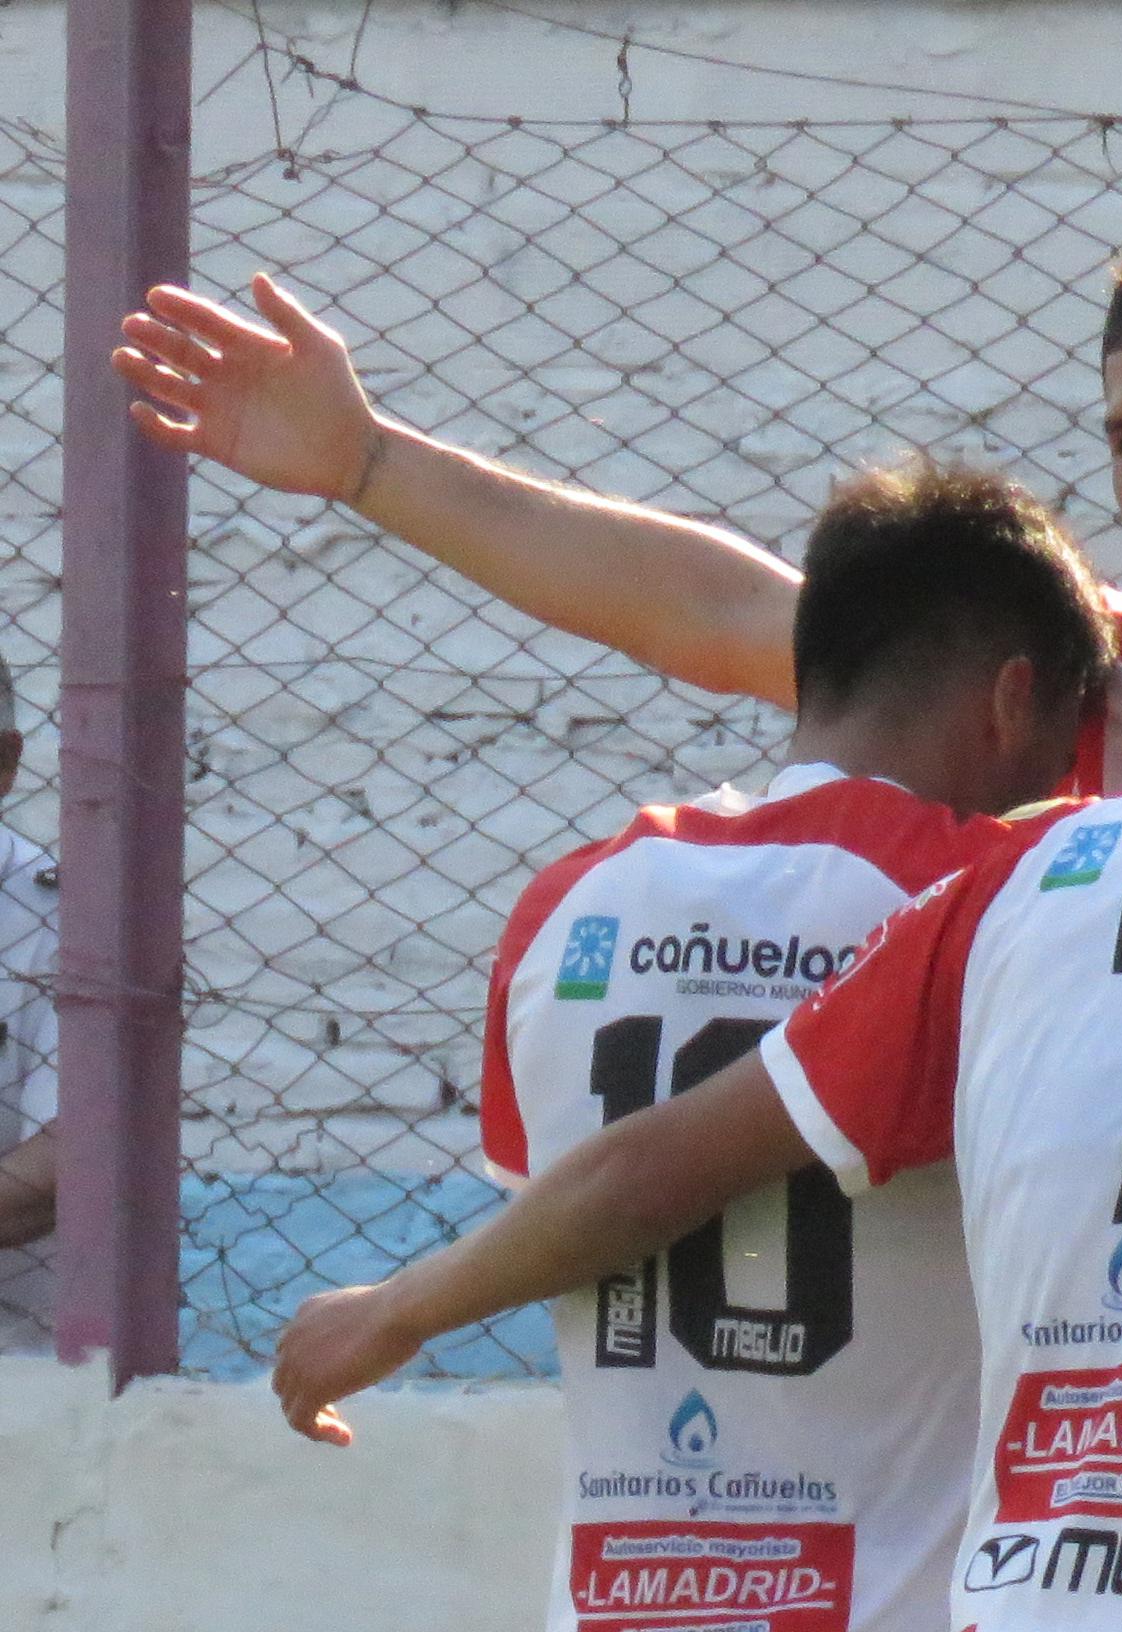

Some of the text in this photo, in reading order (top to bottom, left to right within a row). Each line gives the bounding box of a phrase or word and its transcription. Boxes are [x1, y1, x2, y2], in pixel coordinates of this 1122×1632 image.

[677, 979, 766, 999] GOBIERNO
[590, 1014, 854, 1377] 10
[578, 1470, 837, 1501] Sanitarios Cañuelas
[604, 1538, 798, 1560] Autoservicio mayorista
